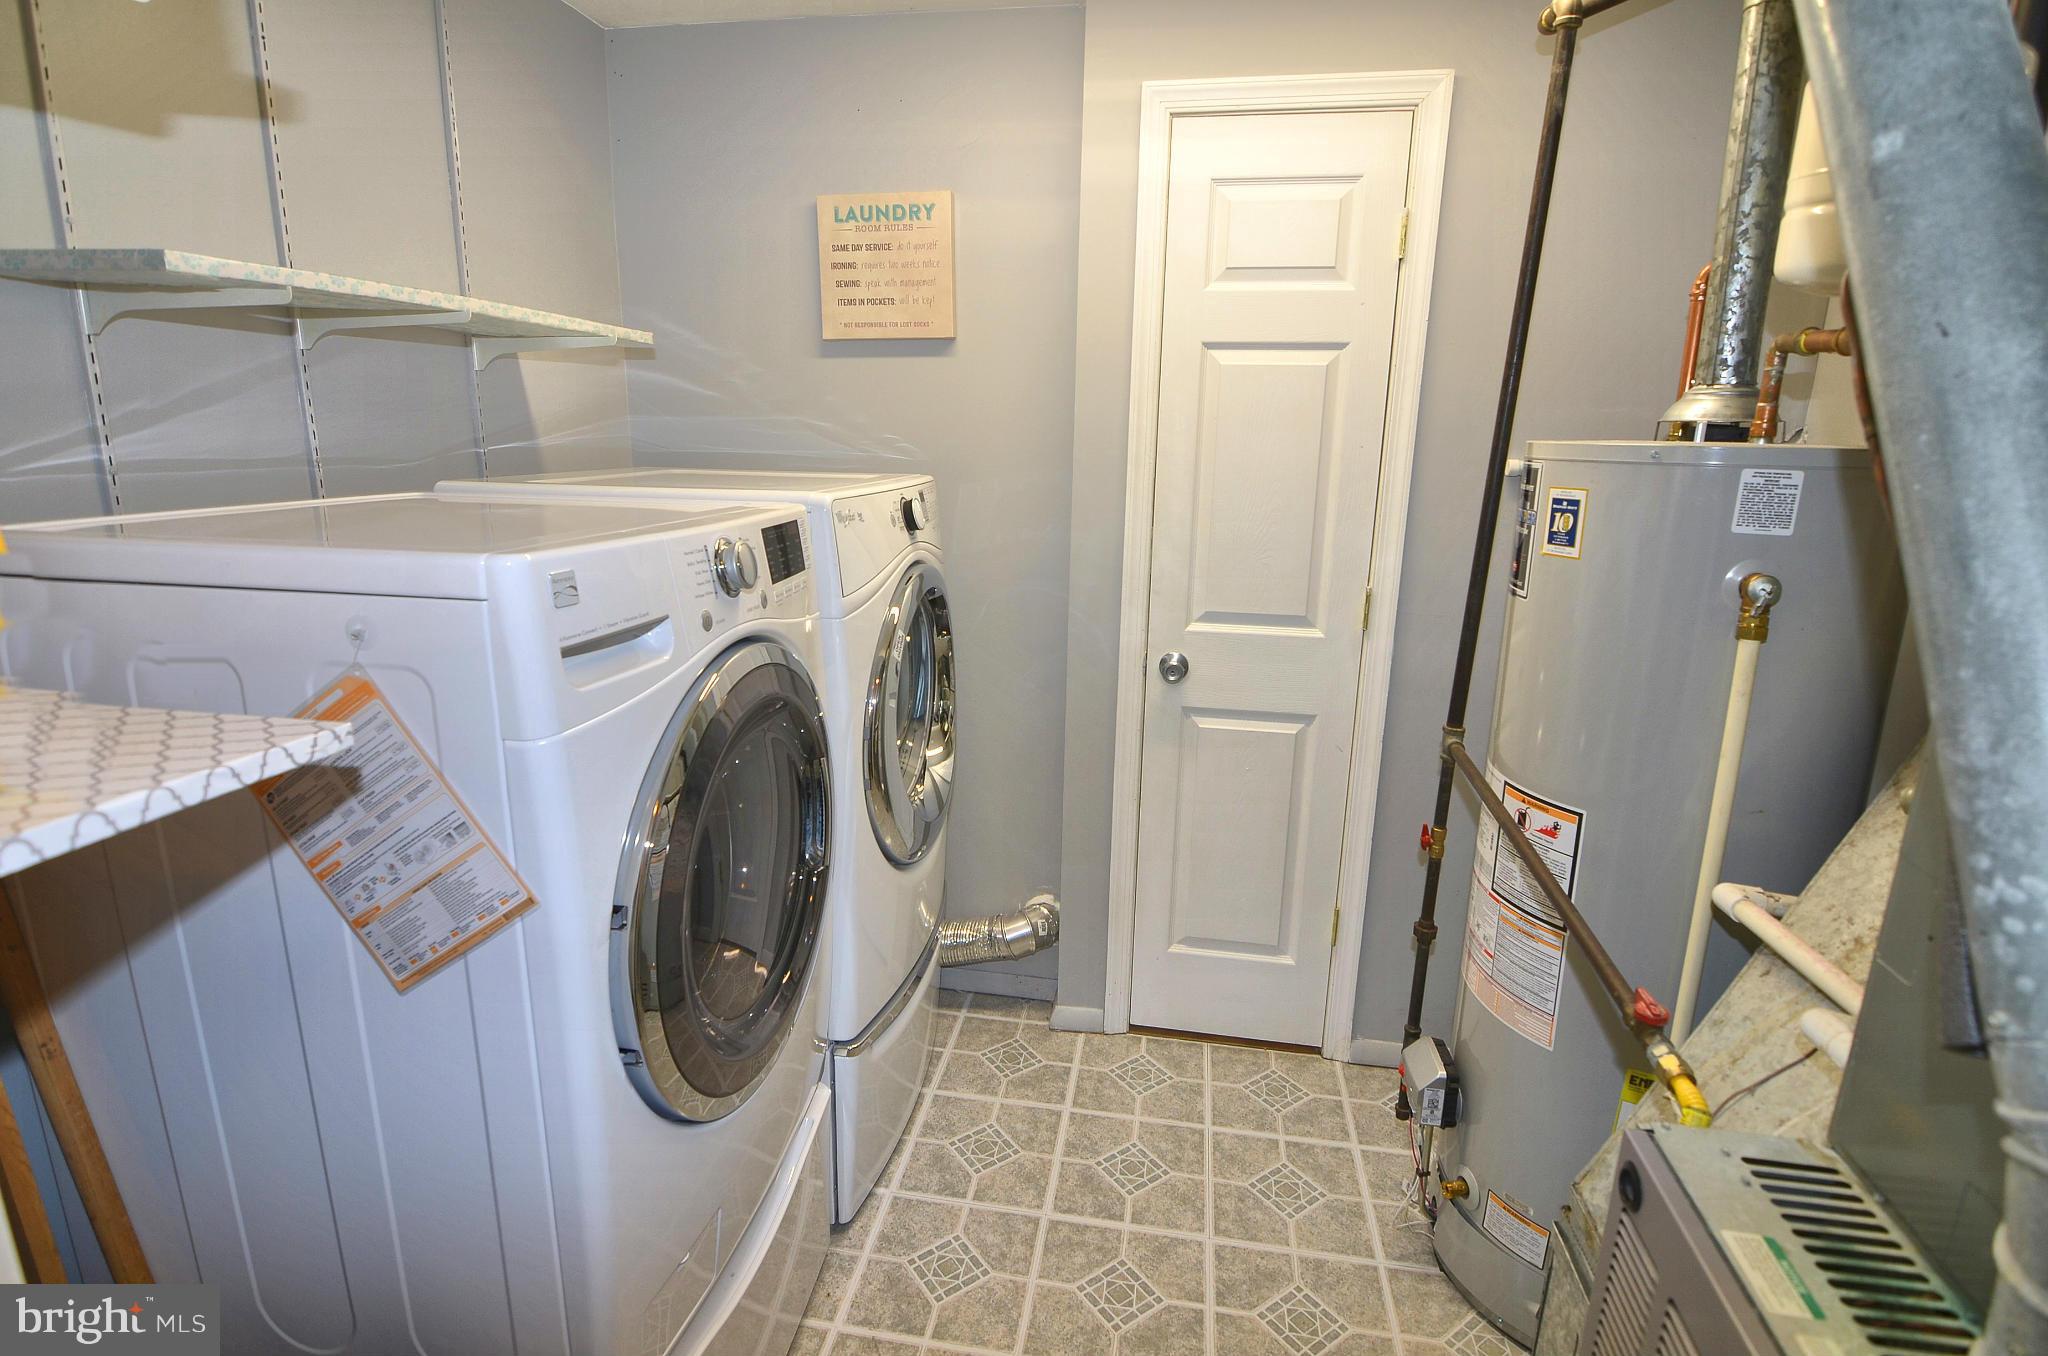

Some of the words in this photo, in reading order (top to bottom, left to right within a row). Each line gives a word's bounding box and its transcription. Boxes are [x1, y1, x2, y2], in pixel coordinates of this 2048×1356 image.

[833, 203, 936, 223] LAUNDRY
[854, 225, 882, 233] ROOM
[884, 223, 914, 232] RULES
[831, 243, 850, 252] SAME
[851, 243, 864, 252] DAY
[864, 242, 893, 252] SERVICE:
[912, 240, 939, 254] yourself
[830, 261, 859, 270] IRONING:
[860, 261, 886, 272] requires
[888, 259, 899, 269] two
[901, 259, 920, 269] weeks
[835, 279, 862, 288] SEWING:
[864, 279, 882, 291] speak
[884, 278, 898, 288] with
[899, 277, 937, 291] management
[837, 298, 857, 307] ITEMS
[858, 298, 865, 306] IN
[866, 297, 896, 306] POCKETS:
[899, 295, 910, 305] will
[854, 321, 888, 329] RESPONSIBLE
[1550, 512, 1574, 533] 10
